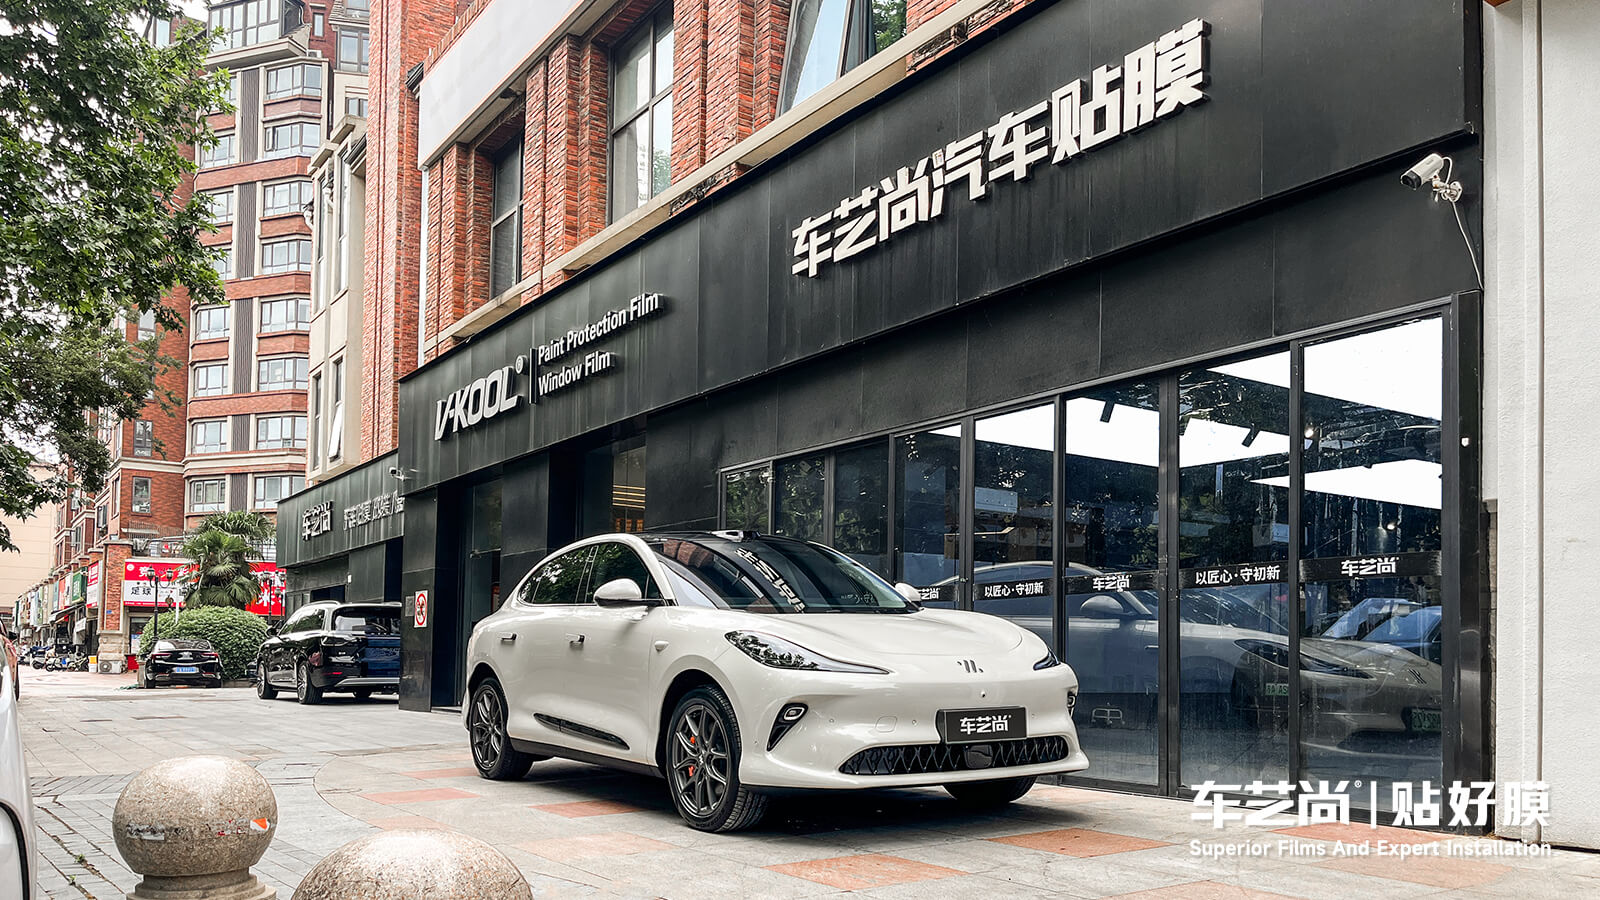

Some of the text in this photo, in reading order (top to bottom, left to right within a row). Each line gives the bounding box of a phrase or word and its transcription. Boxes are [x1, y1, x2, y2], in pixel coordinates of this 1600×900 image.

[791, 18, 1206, 278] 车艺尚汽车贴膜
[538, 293, 660, 366] Paint Protection Film
[538, 351, 611, 396] Window Film
[434, 366, 519, 441] V-KOOL
[302, 501, 333, 541] 车艺尚
[1092, 573, 1131, 591] 车艺尚
[1340, 557, 1398, 577] 车艺尚
[959, 714, 1009, 735] 车艺尚
